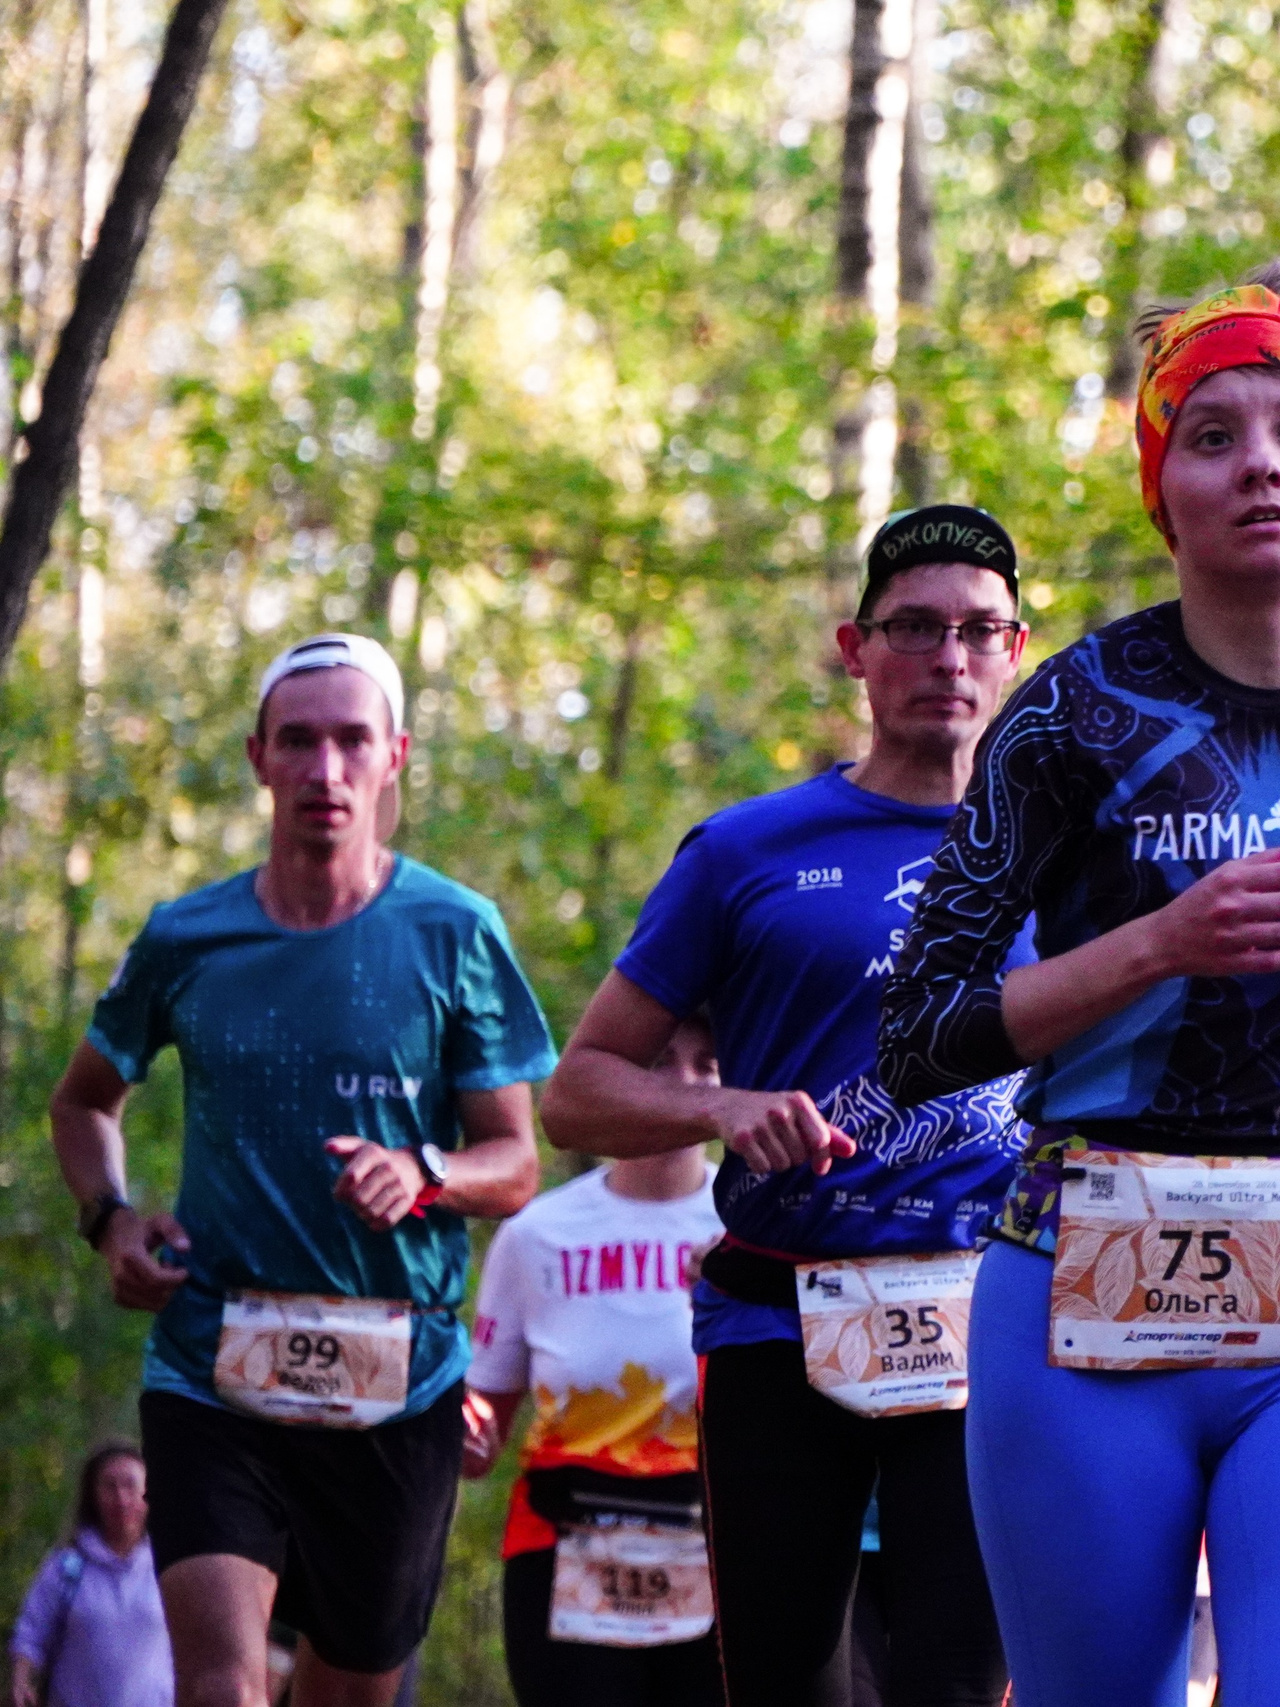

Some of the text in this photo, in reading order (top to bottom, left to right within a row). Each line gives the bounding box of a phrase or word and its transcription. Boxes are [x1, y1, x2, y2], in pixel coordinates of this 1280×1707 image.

[1133, 812, 1266, 861] PARMA
[796, 867, 843, 886] 2018
[335, 1073, 360, 1099] U
[1166, 1192, 1223, 1204] Backyard
[1229, 1191, 1264, 1202] Ultra
[1159, 1230, 1232, 1281] 75
[1145, 1288, 1237, 1314] Ольга
[885, 1306, 942, 1347] 35
[288, 1332, 339, 1369] 99
[881, 1351, 954, 1373] Вадим
[601, 1563, 671, 1599] 119
